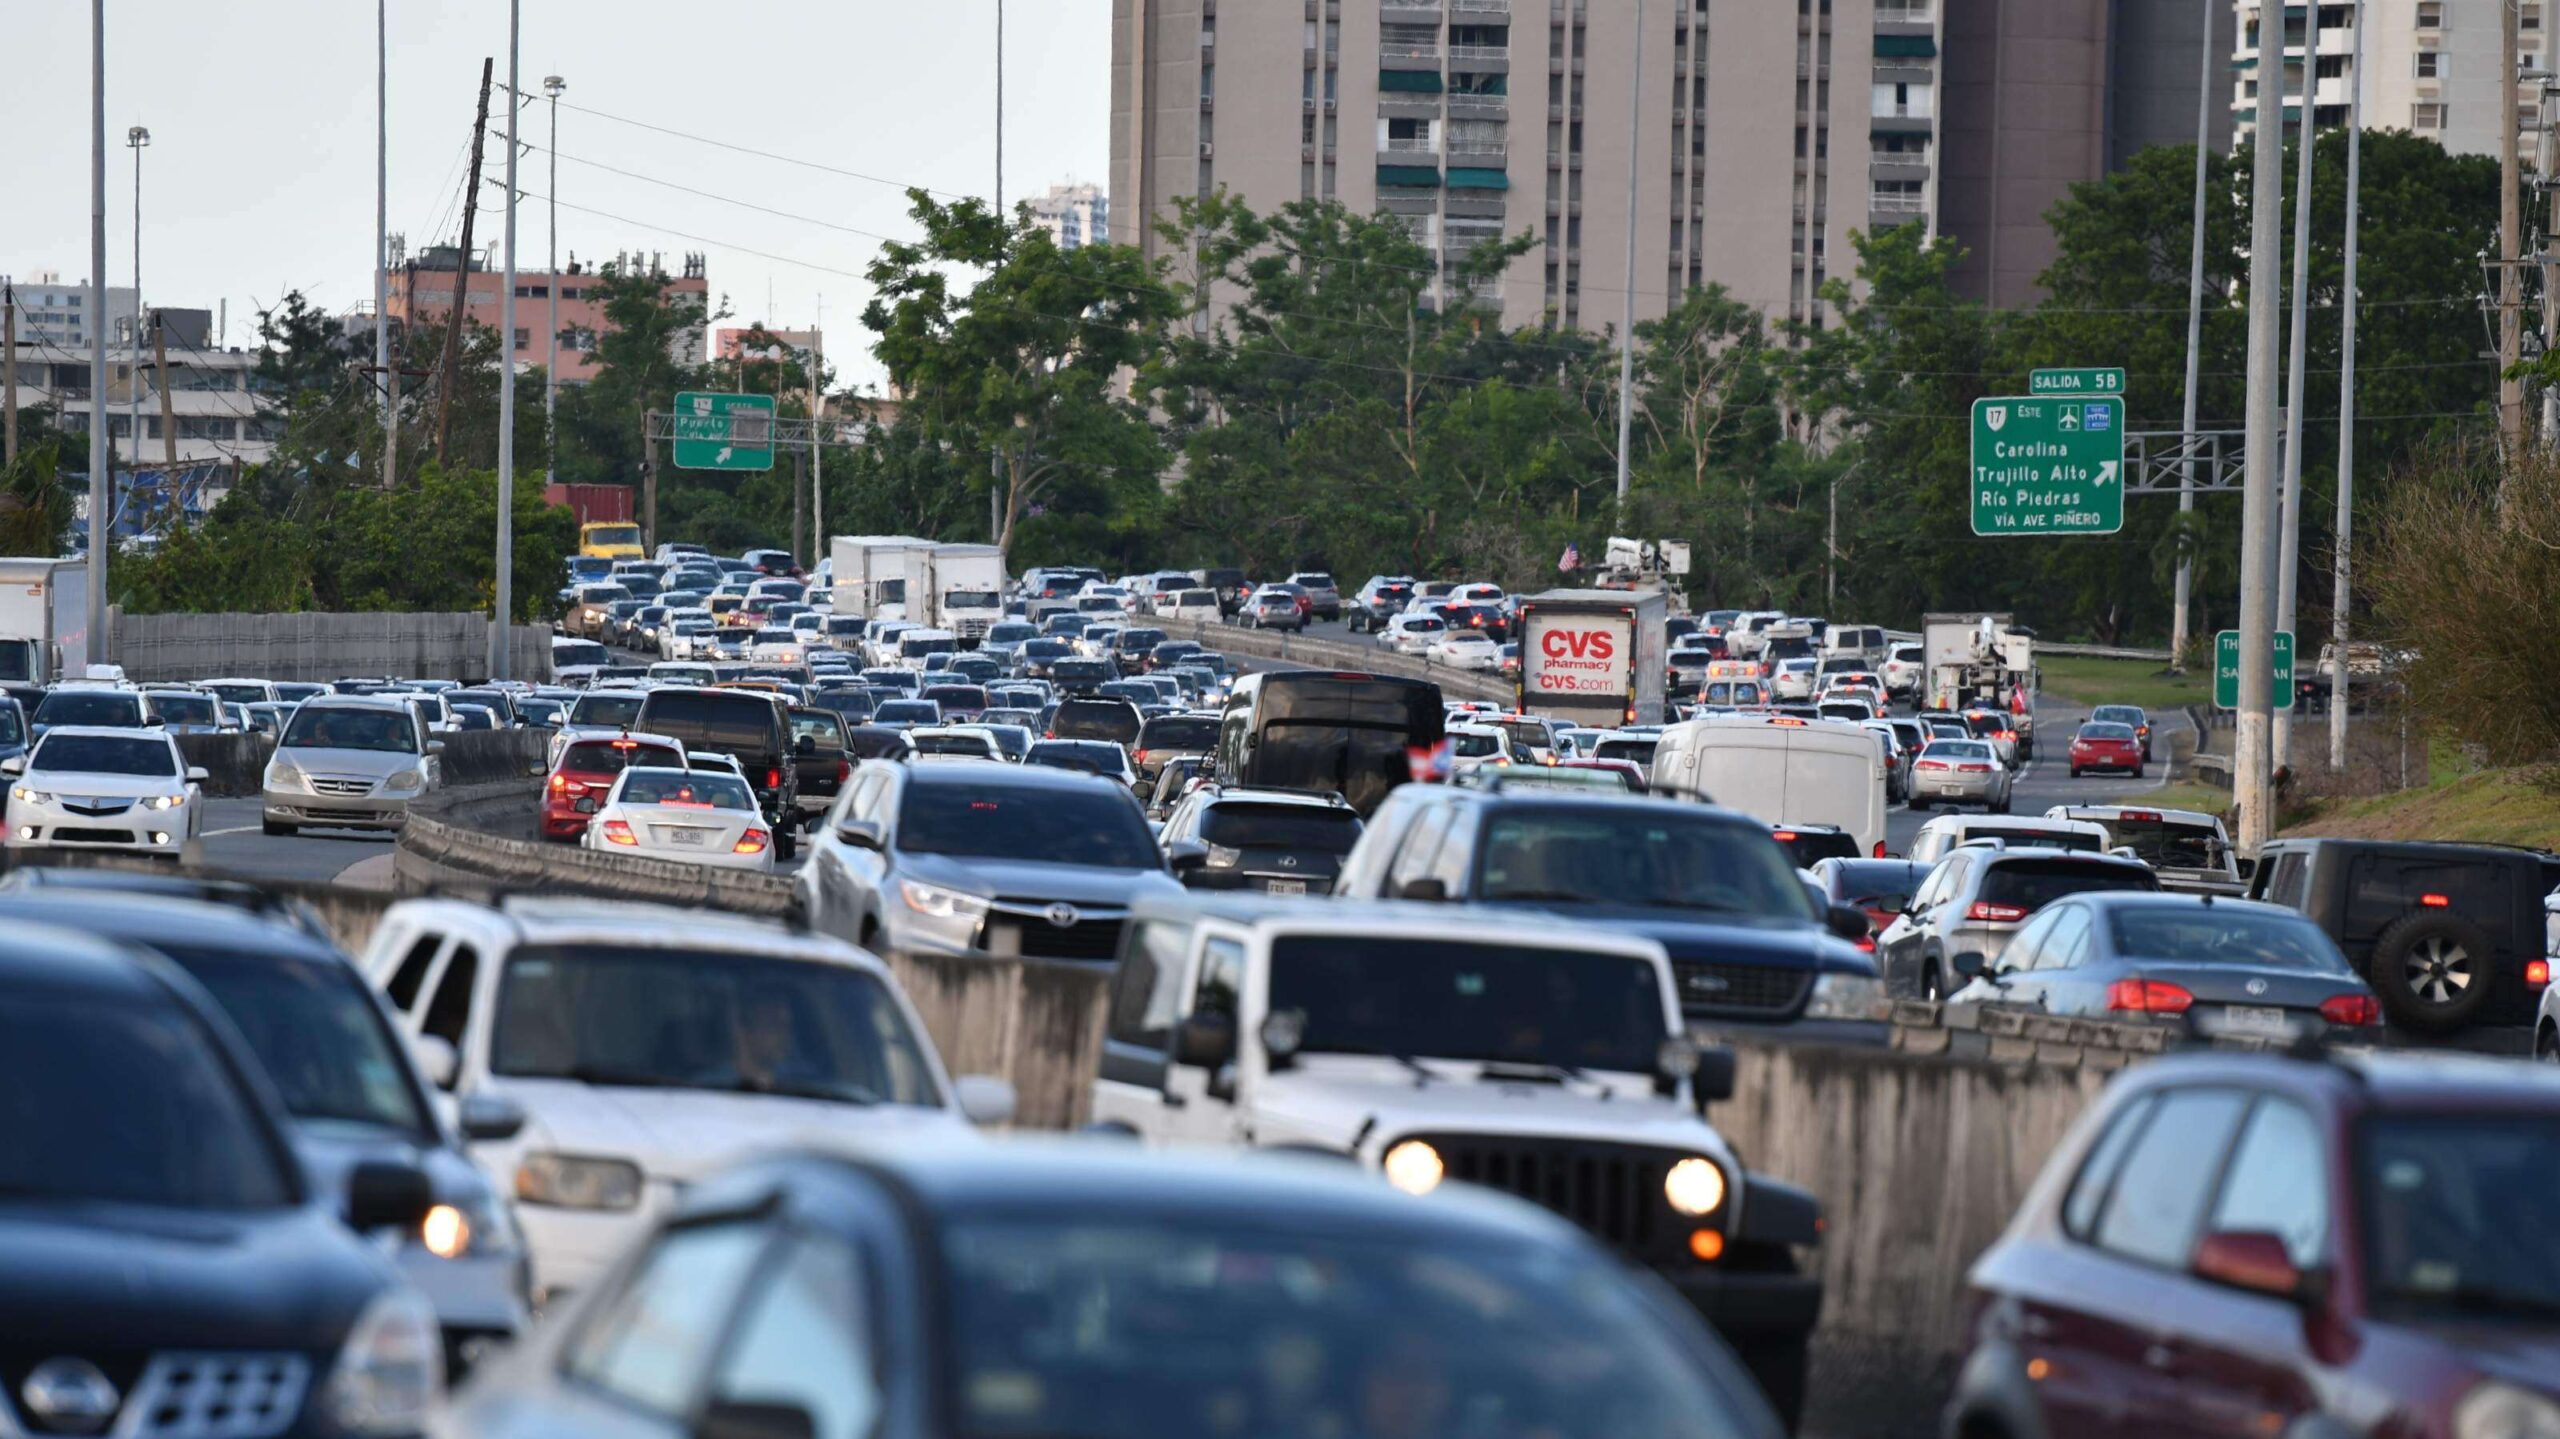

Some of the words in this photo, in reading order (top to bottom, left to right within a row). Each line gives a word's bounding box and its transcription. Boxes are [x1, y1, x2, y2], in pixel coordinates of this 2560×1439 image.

[2034, 375, 2081, 388] SALIDA
[1990, 410, 2001, 424] 17
[2018, 405, 2041, 418] ESTE
[1995, 441, 2068, 458] Carolina
[1977, 466, 2039, 487] Trujillo
[2050, 465, 2087, 480] Alto
[1981, 490, 2007, 507] Río
[2016, 489, 2081, 507] Piedras
[2053, 510, 2101, 526] PIÑERO
[1542, 630, 1613, 659] CVS
[1544, 658, 1611, 672] pharmacy
[1540, 675, 1613, 691] CVS.com
